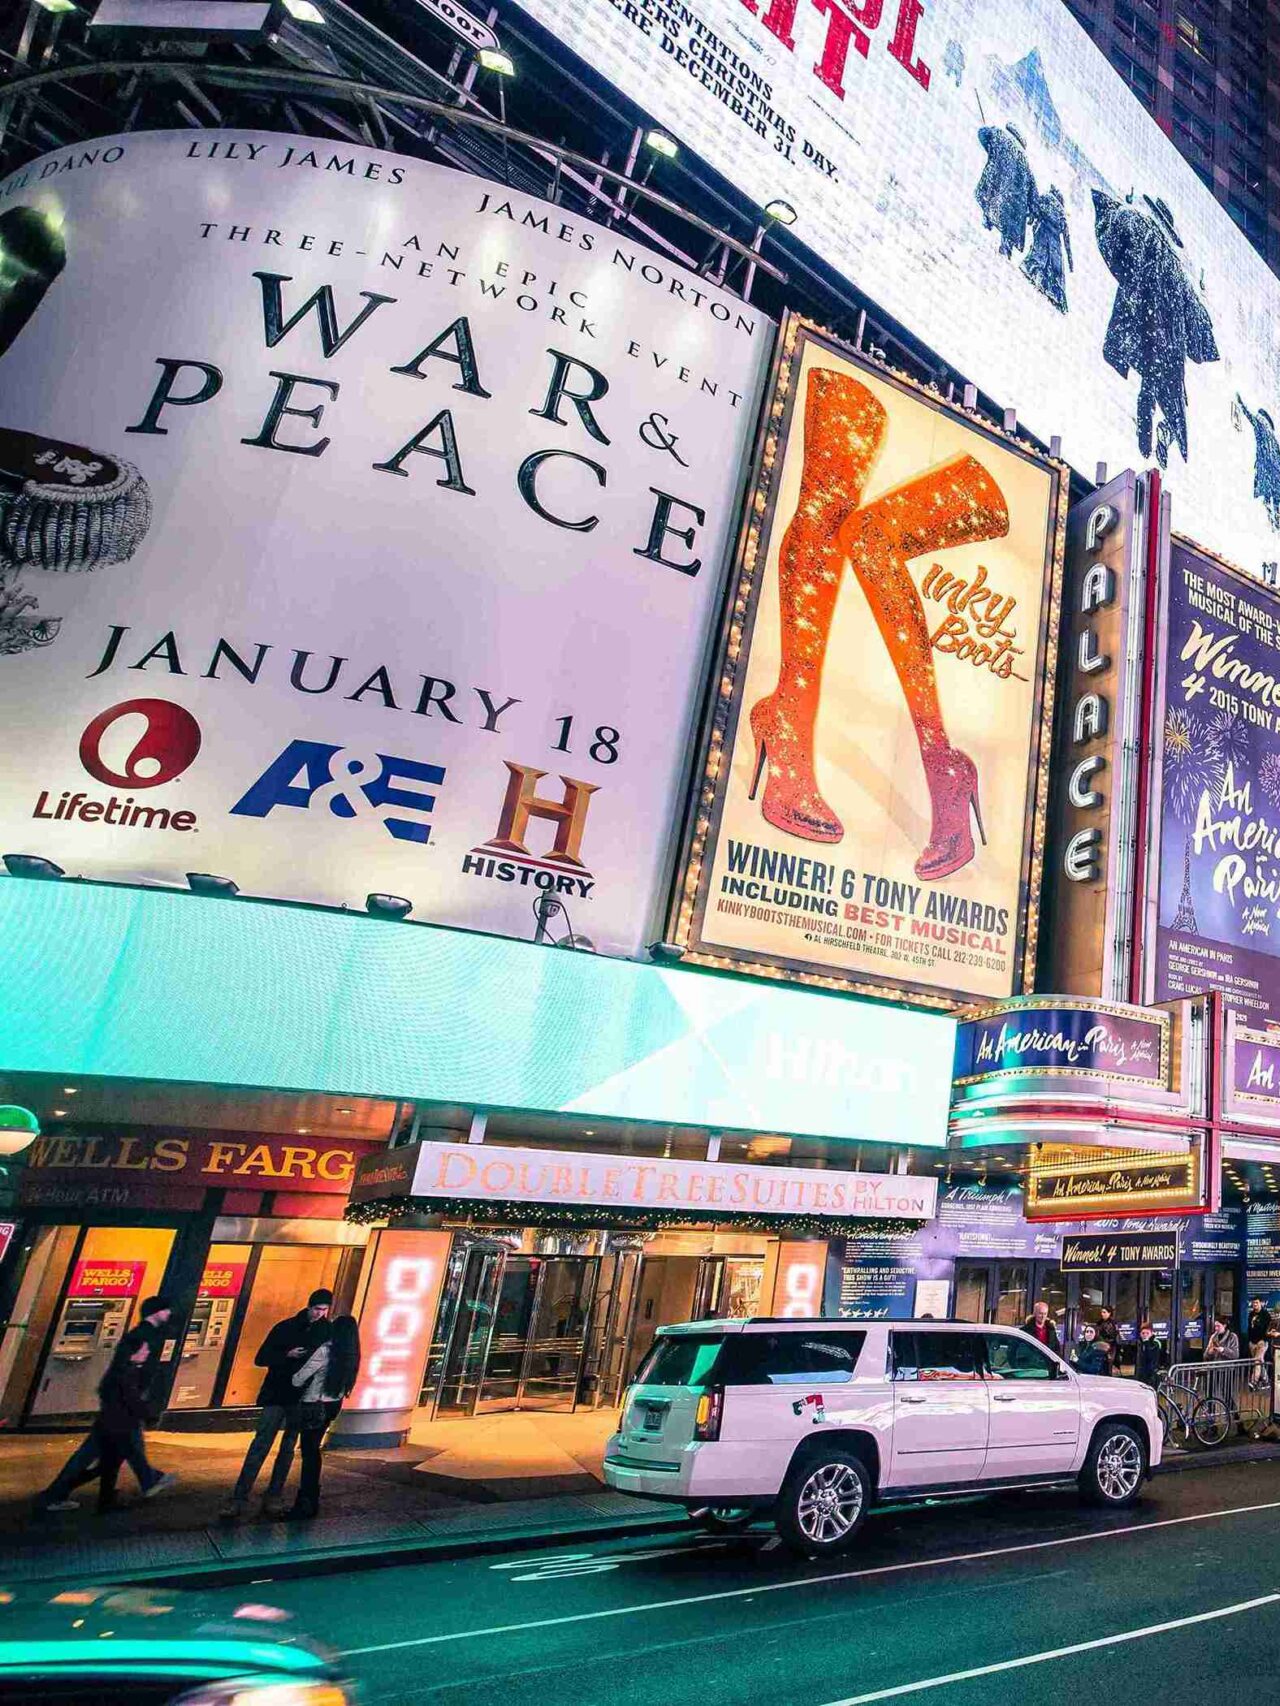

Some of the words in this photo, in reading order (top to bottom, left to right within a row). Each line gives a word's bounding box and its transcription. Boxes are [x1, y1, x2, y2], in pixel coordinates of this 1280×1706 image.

[660, 33, 768, 139] DECEMBER
[773, 136, 796, 166] 31.
[688, 37, 797, 143] CHRISTMAS
[802, 139, 839, 184] DAY.
[40, 146, 125, 179] DANO
[187, 140, 268, 165] LILY
[278, 146, 407, 187] JAMES
[403, 233, 462, 263] AN
[494, 260, 590, 309] EPIC
[477, 192, 596, 253] JAMES
[612, 248, 756, 337] NORTON
[199, 221, 599, 339] THREE-NETWORK
[626, 340, 744, 408] EVENT
[251, 270, 611, 446] WAR
[638, 411, 690, 468] &
[124, 356, 706, 579] PEACE
[1183, 569, 1204, 592] THE
[1206, 582, 1237, 609] MOST
[1188, 590, 1237, 628] MUSICAL
[1239, 618, 1252, 635] OF
[1254, 624, 1274, 647] THE
[930, 613, 1031, 683] Boots
[86, 624, 522, 734] JANUARY
[549, 714, 621, 766] 18
[1064, 504, 1120, 884] PALACE
[1181, 672, 1206, 702] 4
[1210, 686, 1239, 716] 2015
[1241, 700, 1273, 731] TONY
[32, 790, 198, 834] Lifetime
[229, 738, 446, 845] A&E
[1218, 761, 1254, 816] An
[461, 853, 595, 900] HISTORY
[728, 839, 834, 895] WINNER!
[840, 869, 855, 899] 6
[863, 873, 922, 915] TONY
[924, 891, 1009, 937] AWARDS
[717, 899, 867, 942] KINKYBOOTSTHEMUSICAL.COM
[875, 932, 893, 948] FOR
[894, 934, 930, 957] TICKETS
[931, 944, 952, 961] CALL
[953, 950, 1006, 972] 212-239-6200
[721, 876, 839, 919] INCLUDING
[844, 902, 905, 932] BEST
[910, 918, 1007, 956] MUSICAL
[994, 1022, 1079, 1063] American
[1085, 1025, 1127, 1066] Paris
[1247, 1050, 1275, 1090] An
[30, 1135, 190, 1172] WELLS
[87, 1187, 130, 1203] ATM
[853, 1196, 924, 1213] HILTON
[855, 1180, 883, 1193] BY
[1064, 1175, 1105, 1197] American
[83, 1268, 132, 1279] WELLS
[1063, 1241, 1105, 1265] Winner!
[1107, 1244, 1118, 1264] 4
[1120, 1246, 1140, 1262] TONY
[1142, 1245, 1175, 1261] AWARDS
[81, 1276, 130, 1287] FARGO
